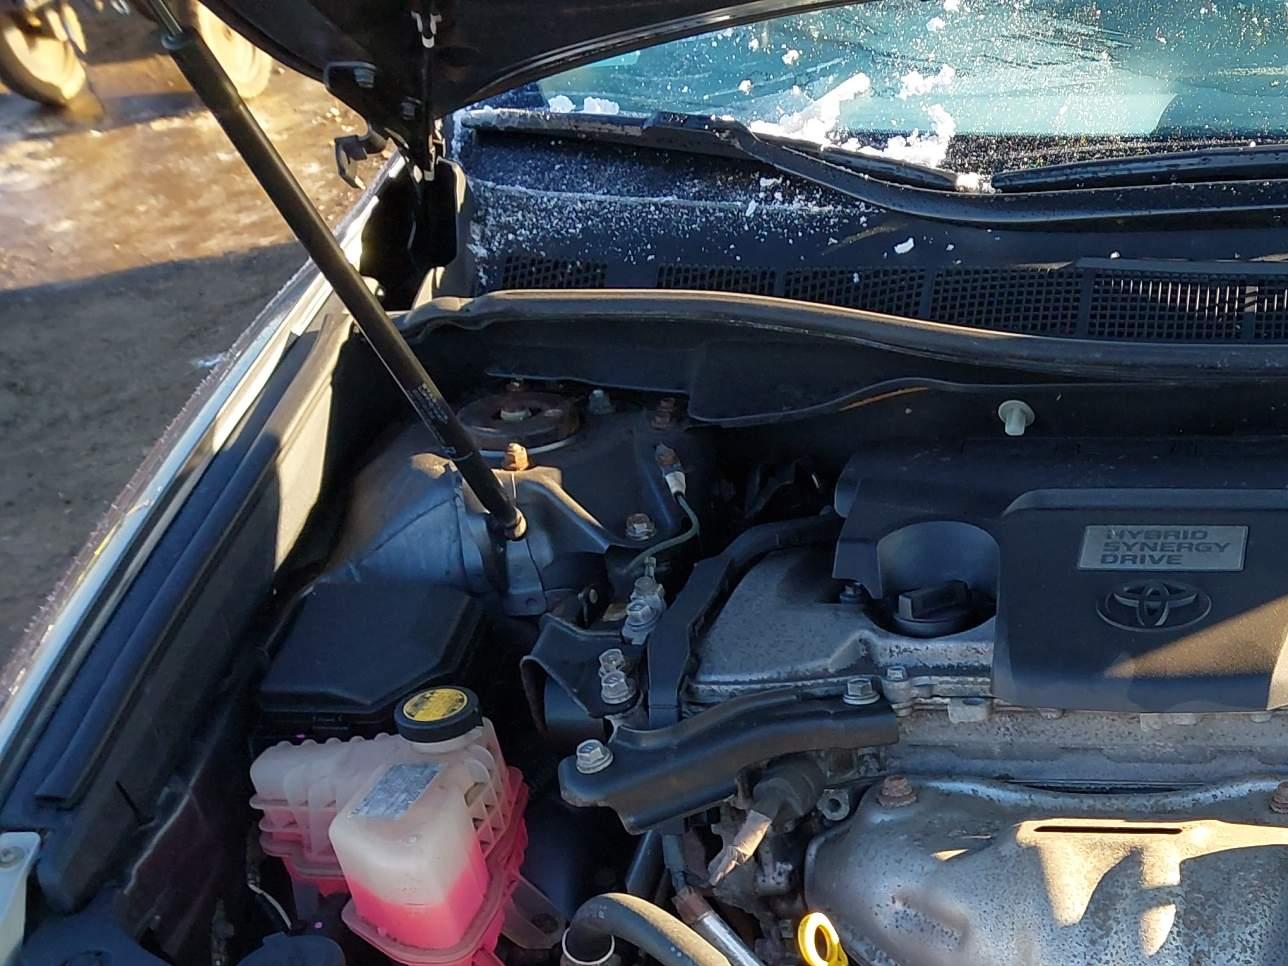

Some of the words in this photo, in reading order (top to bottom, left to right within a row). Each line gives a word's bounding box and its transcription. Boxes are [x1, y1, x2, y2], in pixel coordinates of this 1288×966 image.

[1106, 529, 1209, 540] HYBRID
[1102, 541, 1231, 553] SYNERGY
[1100, 554, 1184, 565] DRIVE
